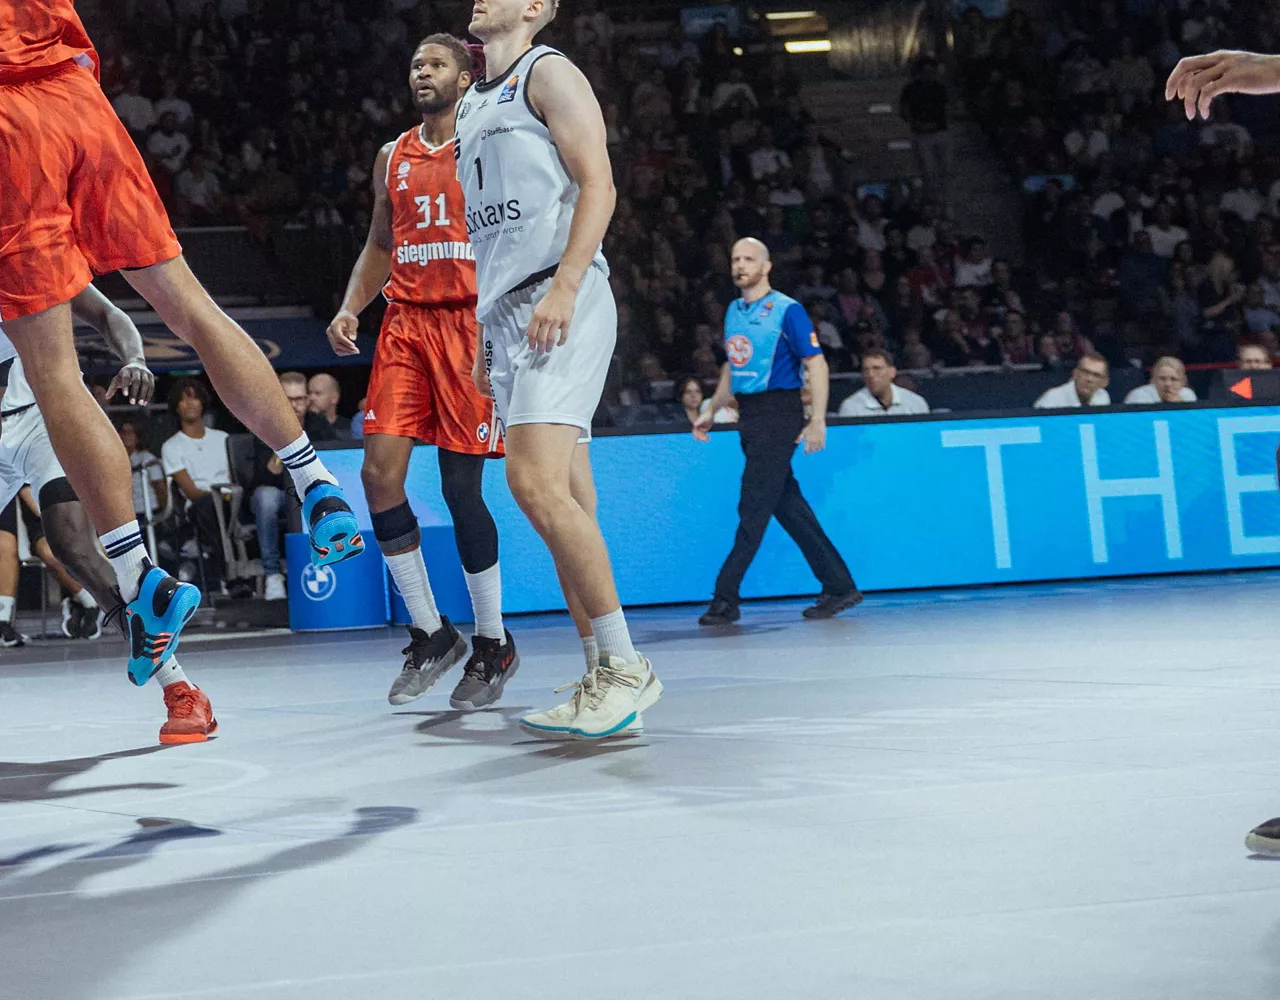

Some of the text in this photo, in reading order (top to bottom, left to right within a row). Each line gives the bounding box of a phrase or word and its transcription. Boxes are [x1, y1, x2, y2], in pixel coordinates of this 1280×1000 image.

[487, 126, 515, 137] Staffbase
[474, 156, 483, 190] 1
[414, 193, 451, 229] 31
